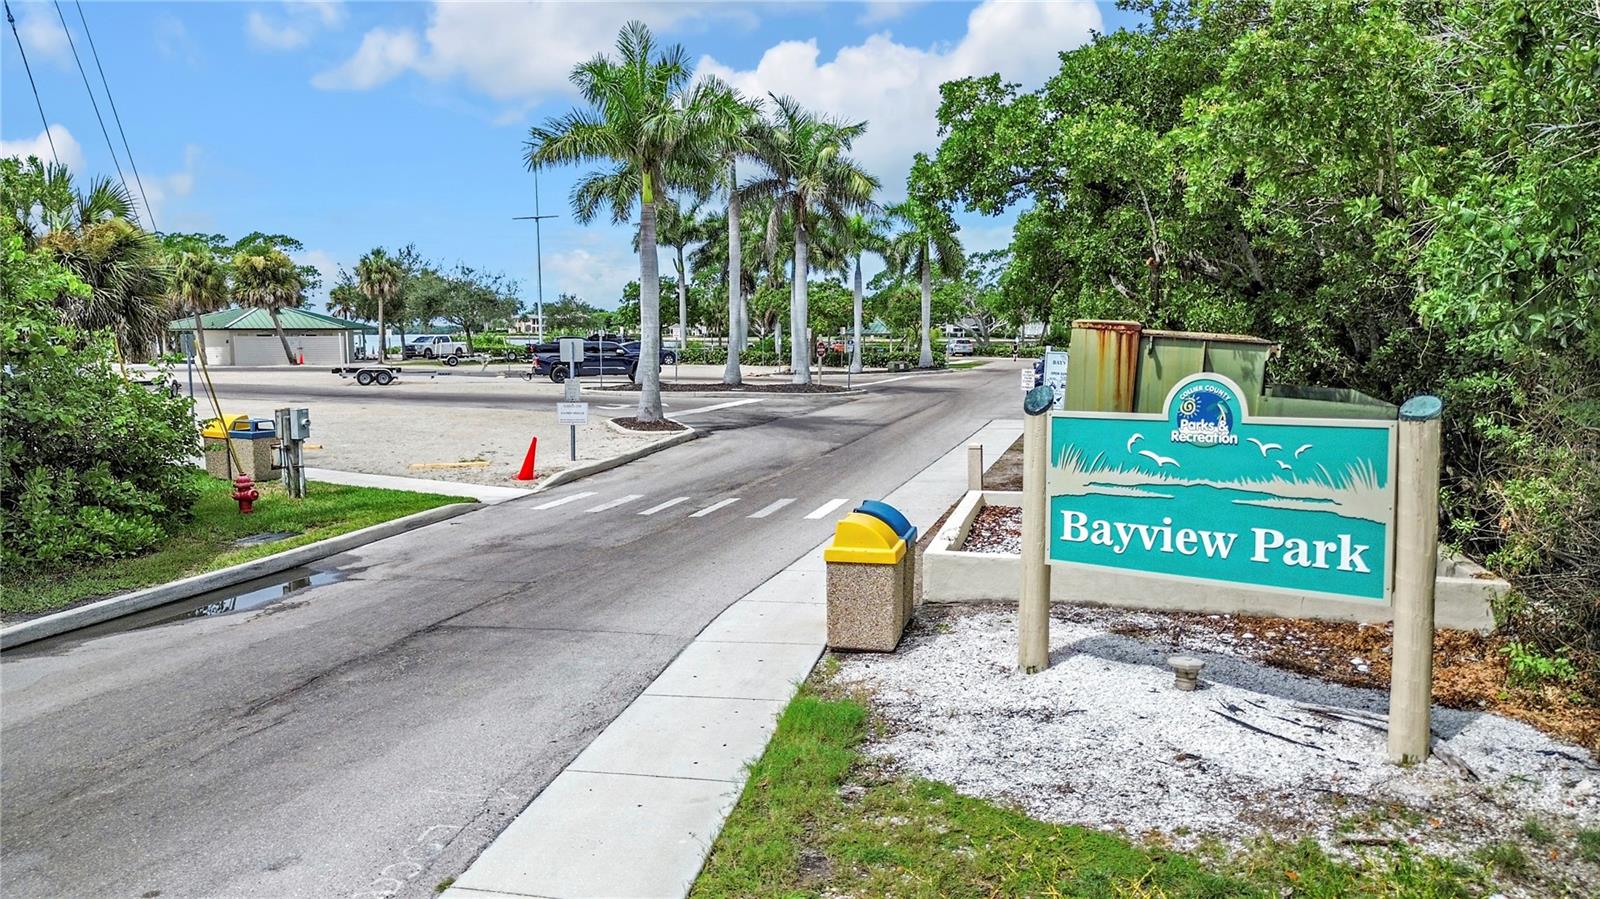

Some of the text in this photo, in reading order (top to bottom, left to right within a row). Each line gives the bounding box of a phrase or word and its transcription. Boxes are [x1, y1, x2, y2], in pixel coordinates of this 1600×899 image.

[1179, 384, 1232, 401] COLLIER COUNTY
[1180, 418, 1229, 432] Parks &
[1171, 430, 1238, 445] Recreation
[1060, 509, 1371, 574] Bayview Park
